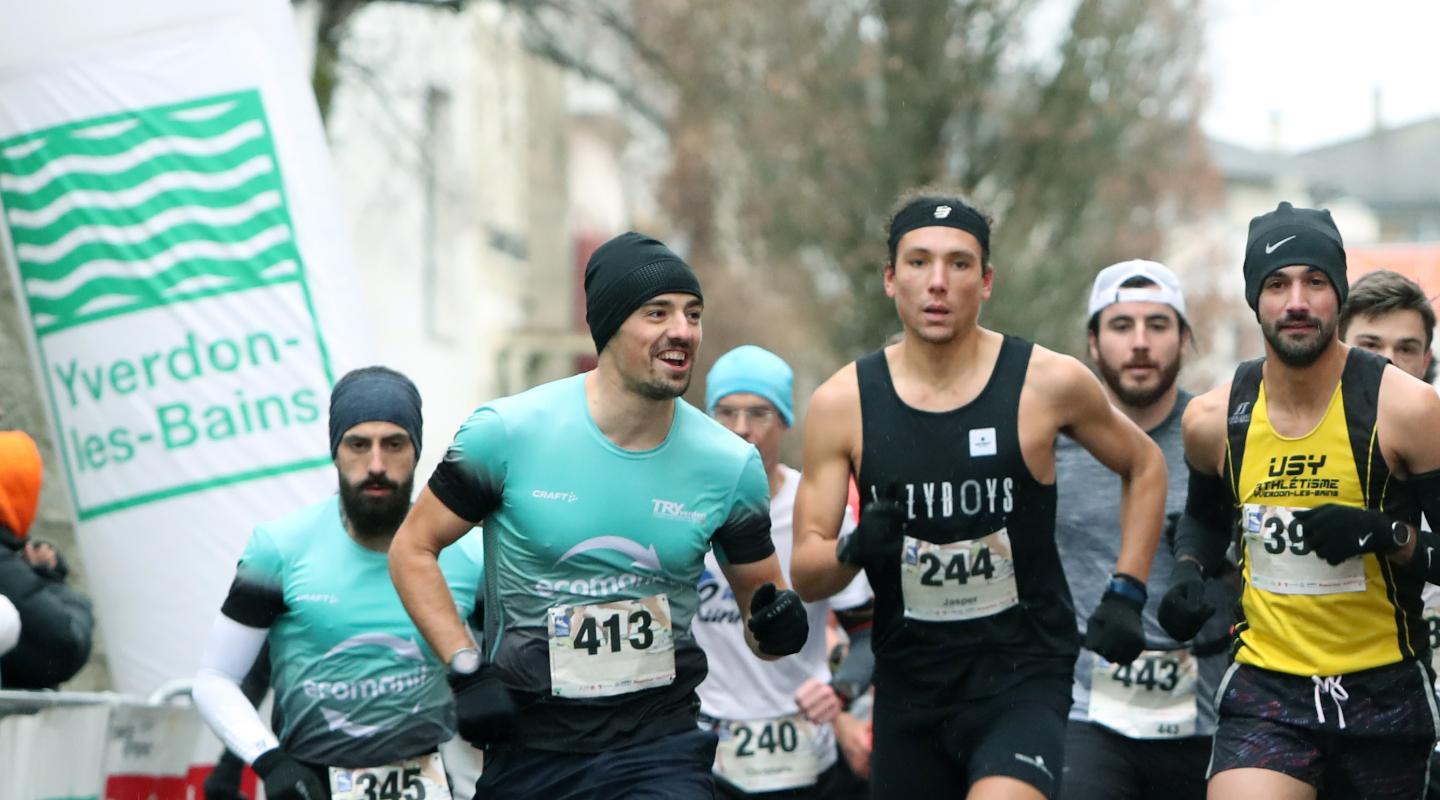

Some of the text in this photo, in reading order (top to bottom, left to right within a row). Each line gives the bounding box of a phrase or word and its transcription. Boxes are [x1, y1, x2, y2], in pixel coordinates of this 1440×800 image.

[55, 331, 299, 407] Yverdon-
[71, 388, 320, 473] les-Bains
[1268, 455, 1327, 477] USY
[532, 489, 568, 500] CRAFT
[871, 477, 1013, 519] ZYBOYS
[920, 547, 995, 587] 244
[573, 610, 654, 656] 413
[1112, 659, 1179, 692] 443
[734, 720, 798, 757] 240
[1157, 724, 1180, 735] 443
[355, 767, 426, 800] 345
